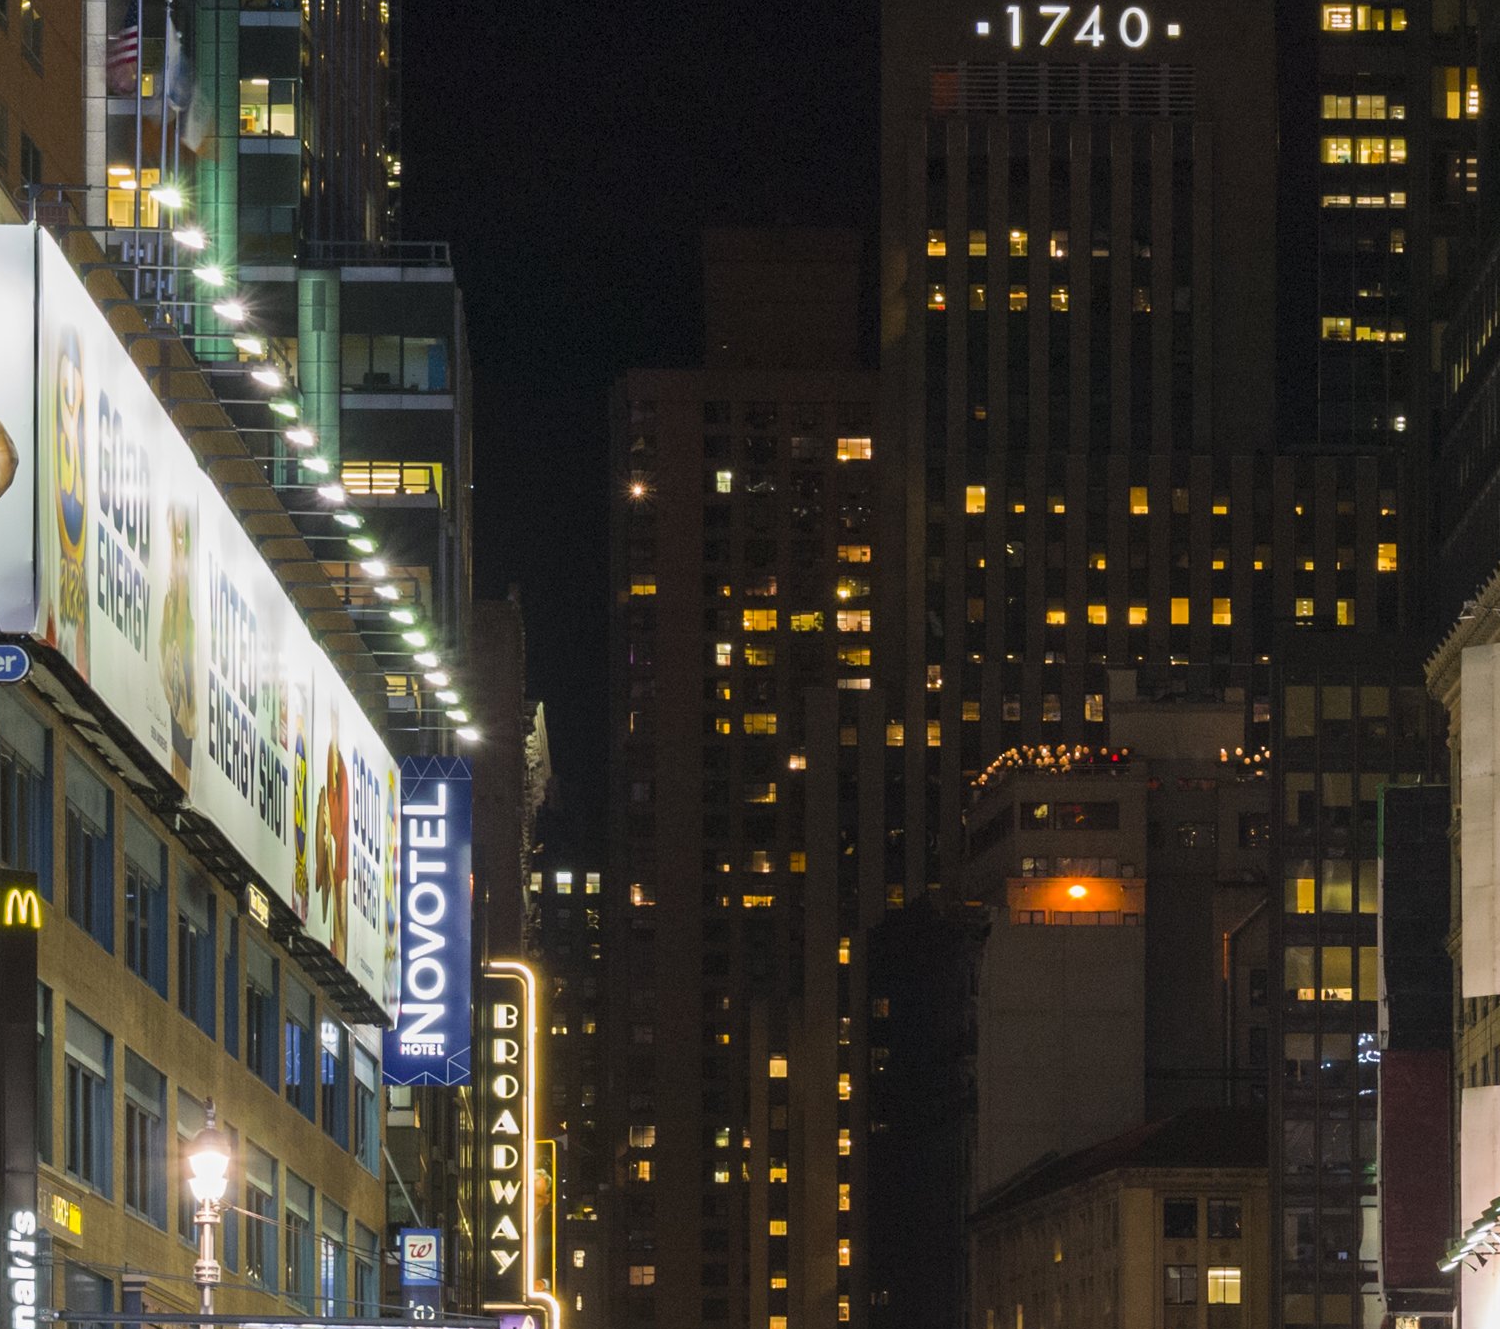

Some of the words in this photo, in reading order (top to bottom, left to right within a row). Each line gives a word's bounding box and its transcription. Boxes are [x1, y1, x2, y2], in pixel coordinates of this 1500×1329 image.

[1005, 5, 1150, 47] 1740
[97, 521, 151, 662] ENERGY
[208, 667, 257, 807] ENERGY
[259, 736, 289, 846] SHOT
[352, 747, 381, 866] GOOD
[352, 841, 382, 935] ENERGY
[400, 783, 446, 1044] NOVOTEL
[401, 1044, 444, 1056] HOTEL
[491, 1004, 523, 1275] BROADWAY
